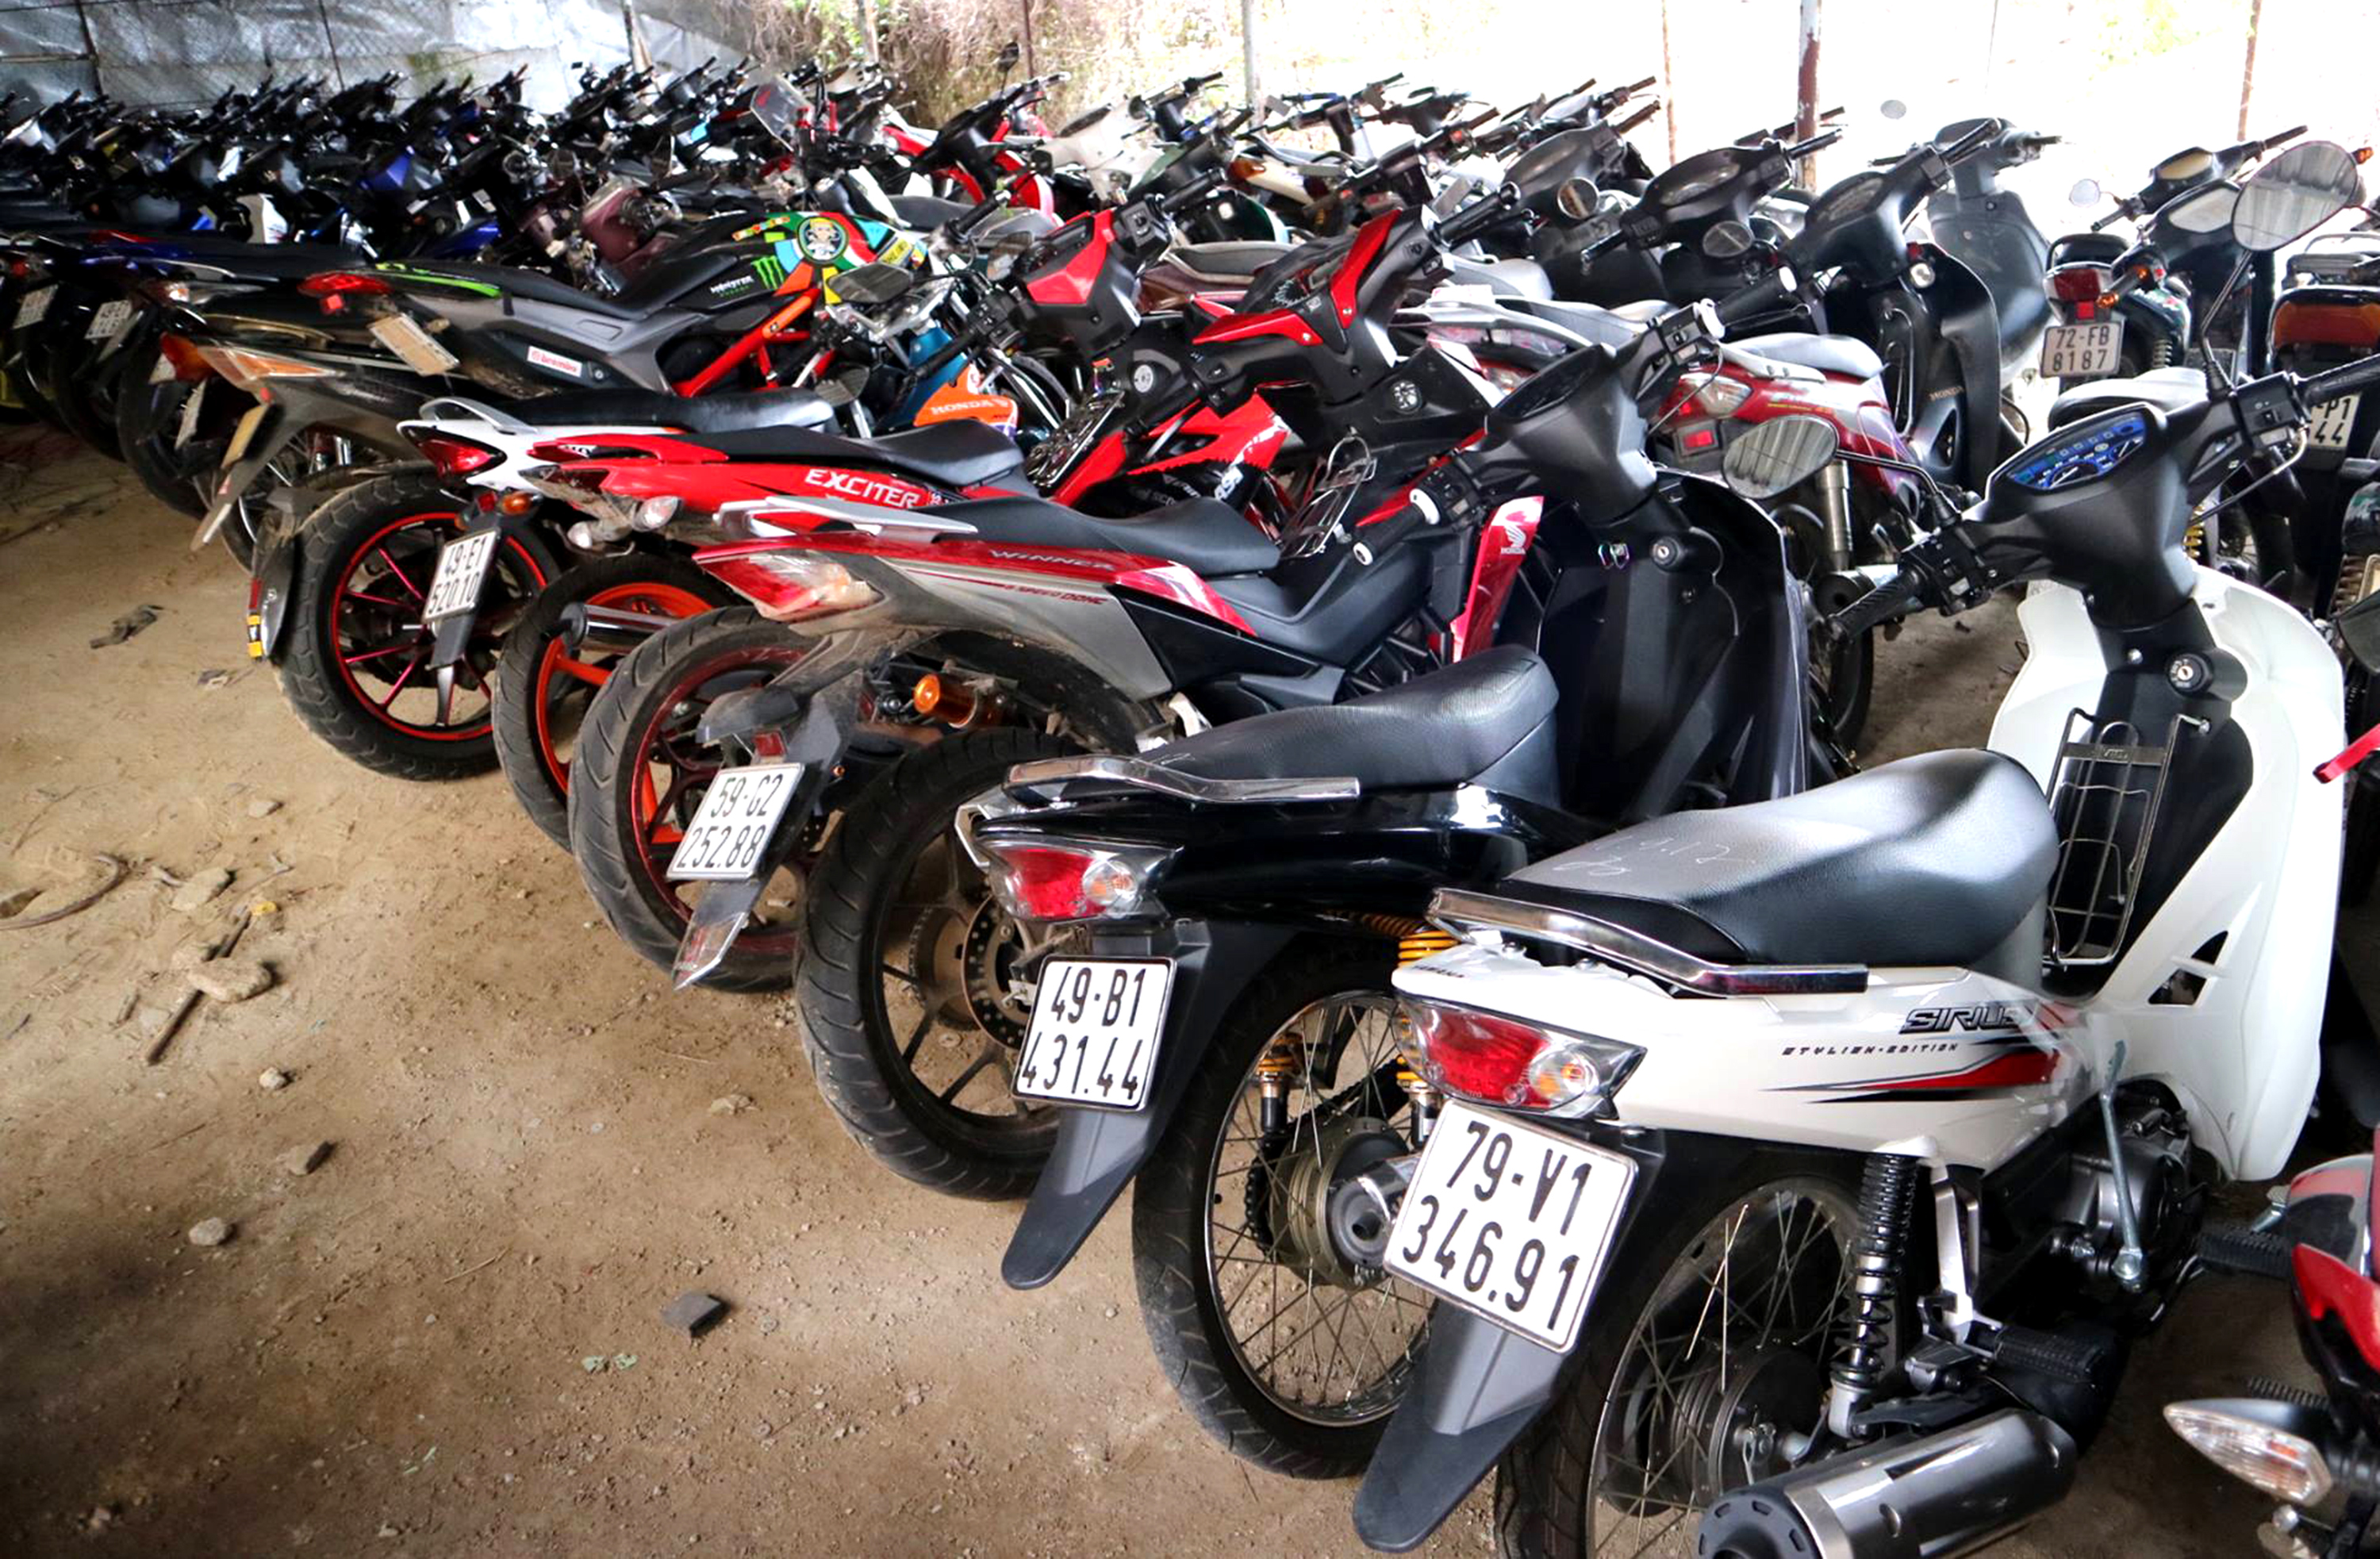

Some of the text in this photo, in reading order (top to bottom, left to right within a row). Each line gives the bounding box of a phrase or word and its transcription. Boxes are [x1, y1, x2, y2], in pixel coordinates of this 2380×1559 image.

[2056, 326, 2110, 349] 72-FB
[2052, 351, 2109, 373] 8187
[931, 399, 994, 415] HONDA
[804, 468, 922, 509] EXCITER
[710, 773, 784, 818] 59-G2
[676, 824, 766, 869] 252.88
[1051, 966, 1146, 1027] 49-B1
[1022, 1031, 1143, 1100] 431.44
[1446, 1119, 1592, 1236] 79-V1
[1402, 1194, 1580, 1331] 346.91
